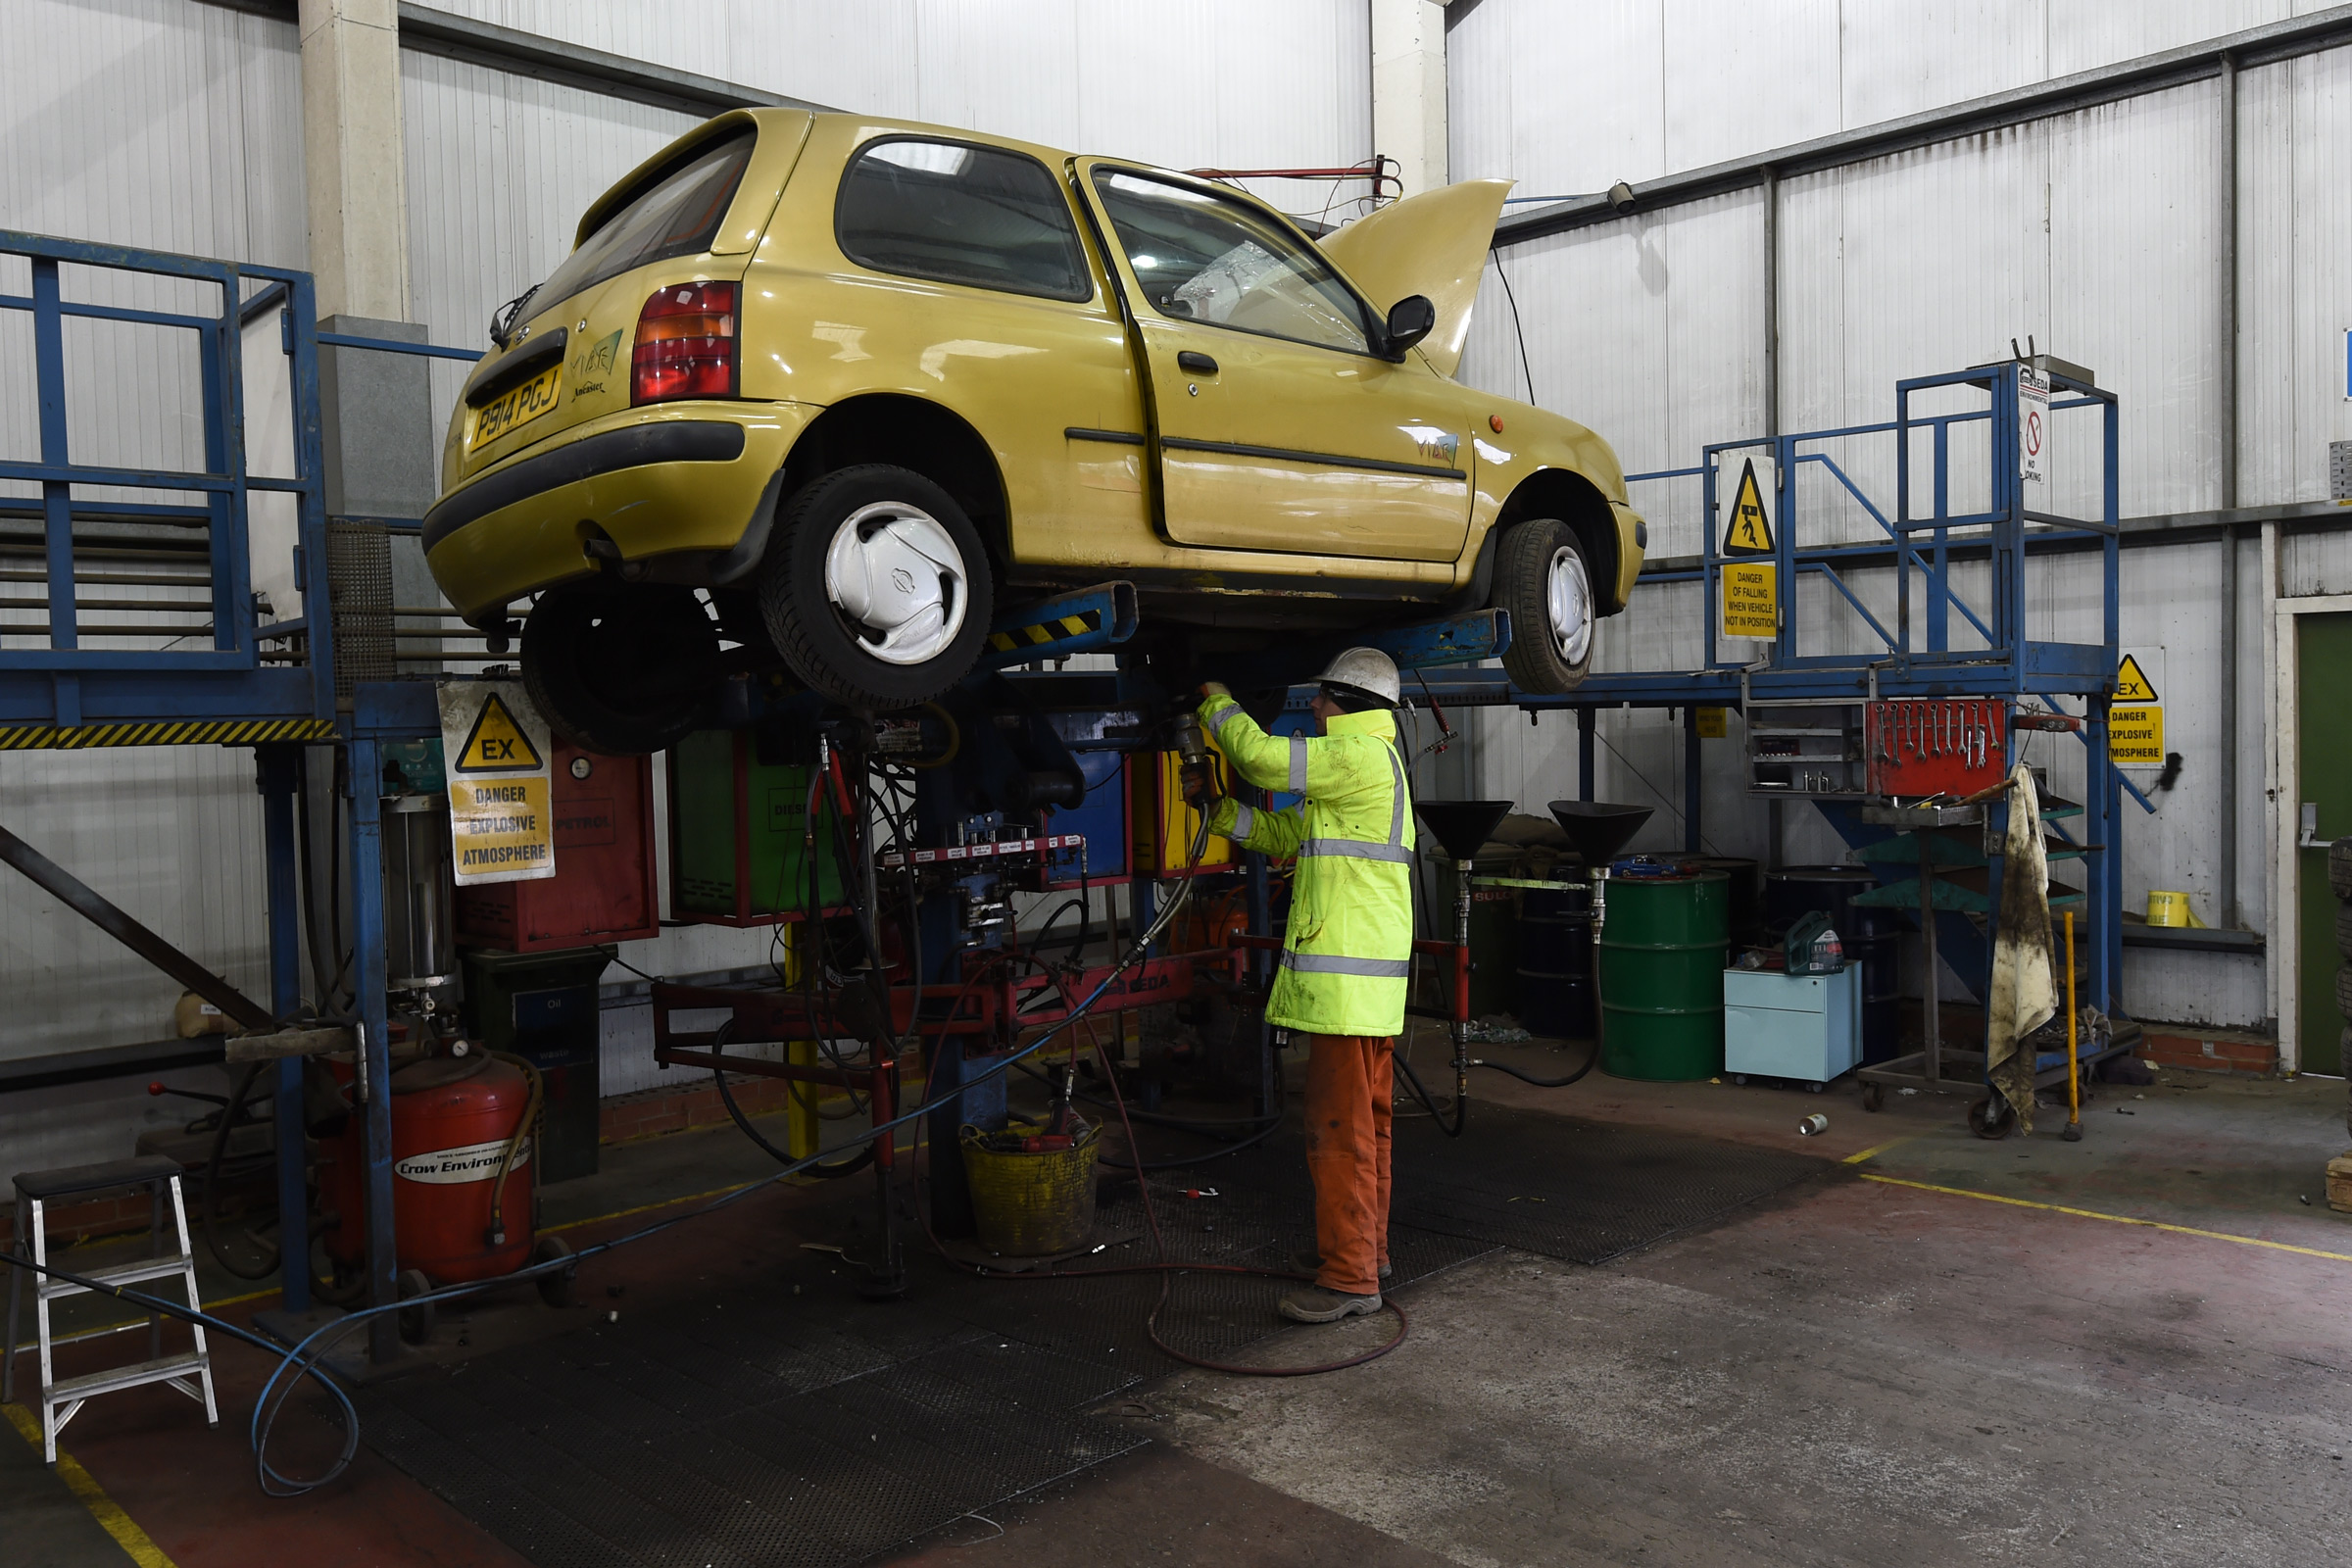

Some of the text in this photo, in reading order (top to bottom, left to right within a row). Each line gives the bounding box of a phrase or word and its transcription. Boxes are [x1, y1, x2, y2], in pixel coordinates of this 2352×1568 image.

[572, 382, 606, 398] Ancaster
[2033, 377, 2048, 390] SEDA
[2020, 391, 2047, 405] ENVIRONMENTAL
[476, 369, 558, 442] P914 PGJ
[2028, 459, 2034, 468] NO
[2025, 470, 2041, 482] OKING
[1738, 572, 1763, 584] DANGER
[1733, 586, 1768, 599] OF FALLING
[1728, 601, 1773, 613] WHEN VEHICLE
[1725, 615, 1776, 628] NOT IN POSITION
[2118, 682, 2139, 696] EX
[2112, 711, 2146, 721] DANGER
[481, 738, 515, 760] EX
[2111, 748, 2159, 758] MOSPHERE
[475, 786, 526, 805] DANGER
[774, 804, 807, 815] DIES
[469, 815, 536, 835] EXPLOSIVE
[556, 815, 612, 831] PETROL
[463, 844, 546, 866] ATMOSPHERE
[547, 998, 562, 1009] Oil
[539, 1050, 569, 1060] waste
[400, 1162, 439, 1174] Crow
